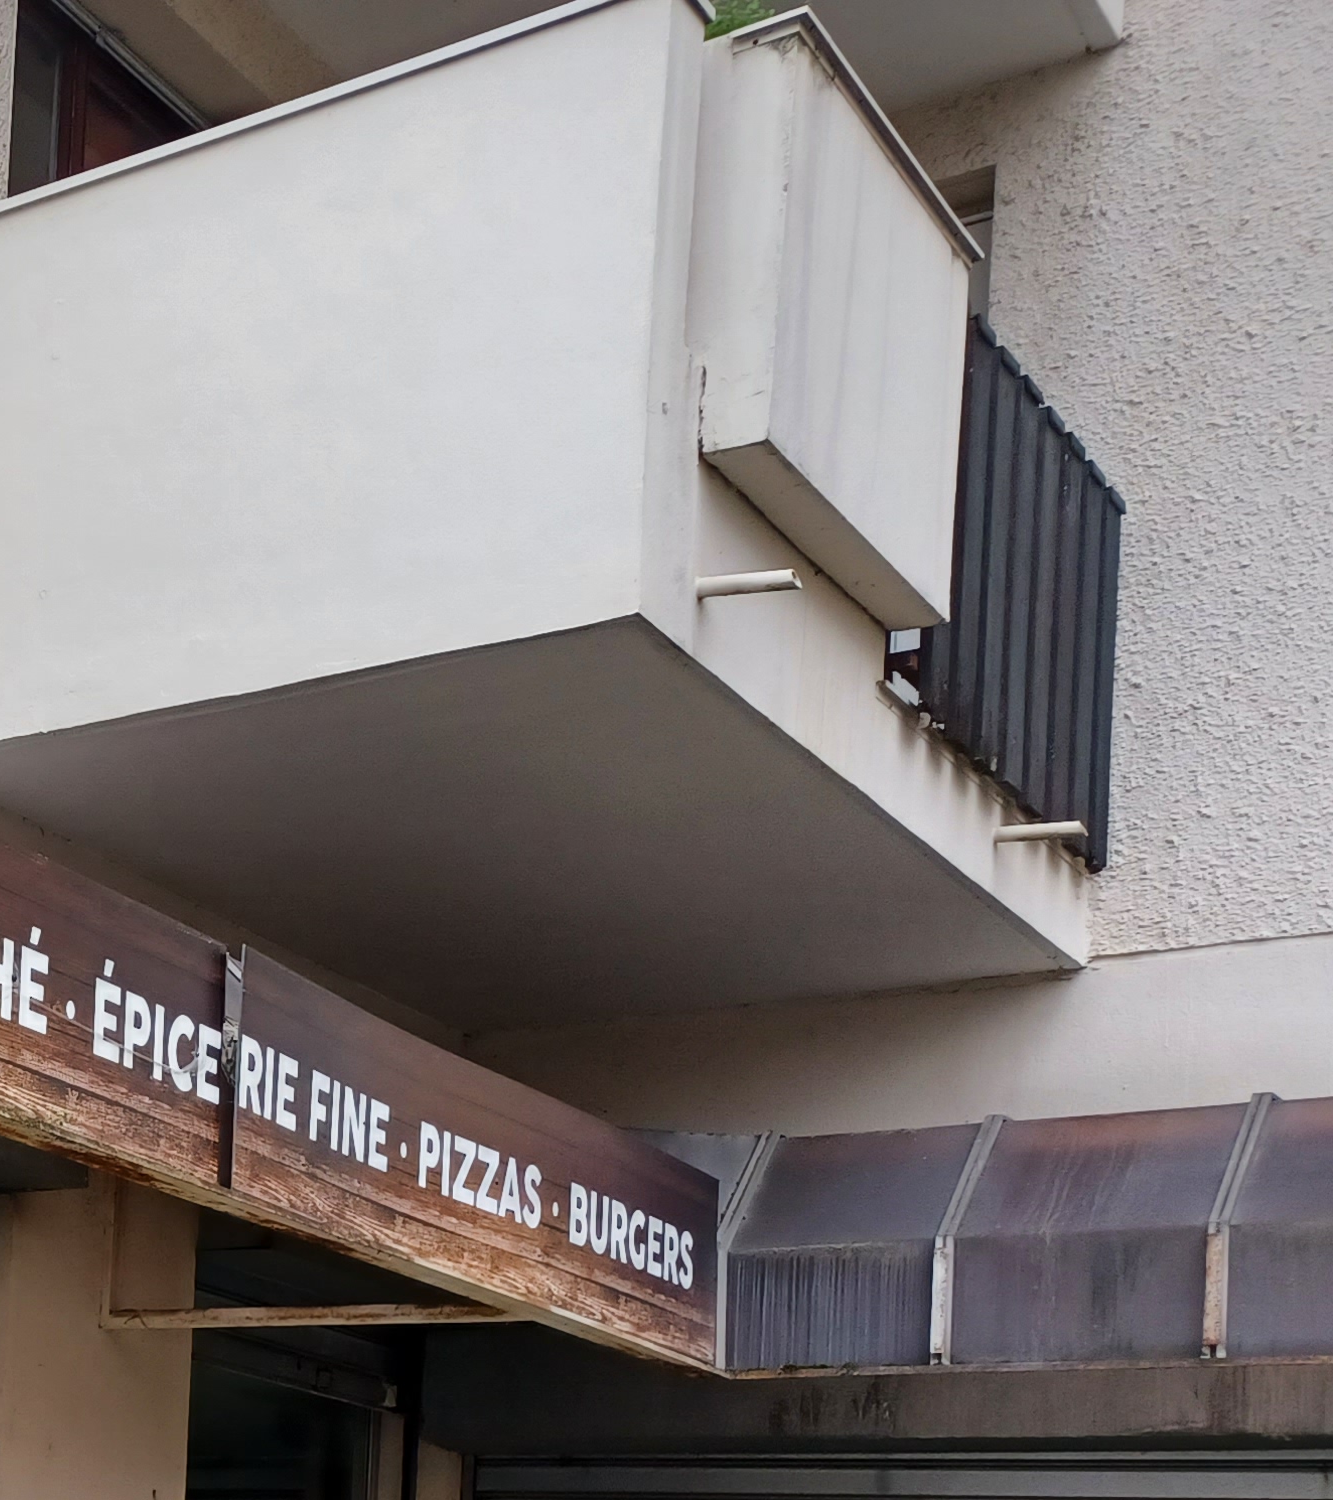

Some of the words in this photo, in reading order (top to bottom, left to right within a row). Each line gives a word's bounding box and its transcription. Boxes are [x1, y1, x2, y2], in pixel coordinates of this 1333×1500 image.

[309, 1069, 390, 1173] FINE
[418, 1120, 542, 1229] PIZZAS
[569, 1181, 693, 1290] BURGERS
